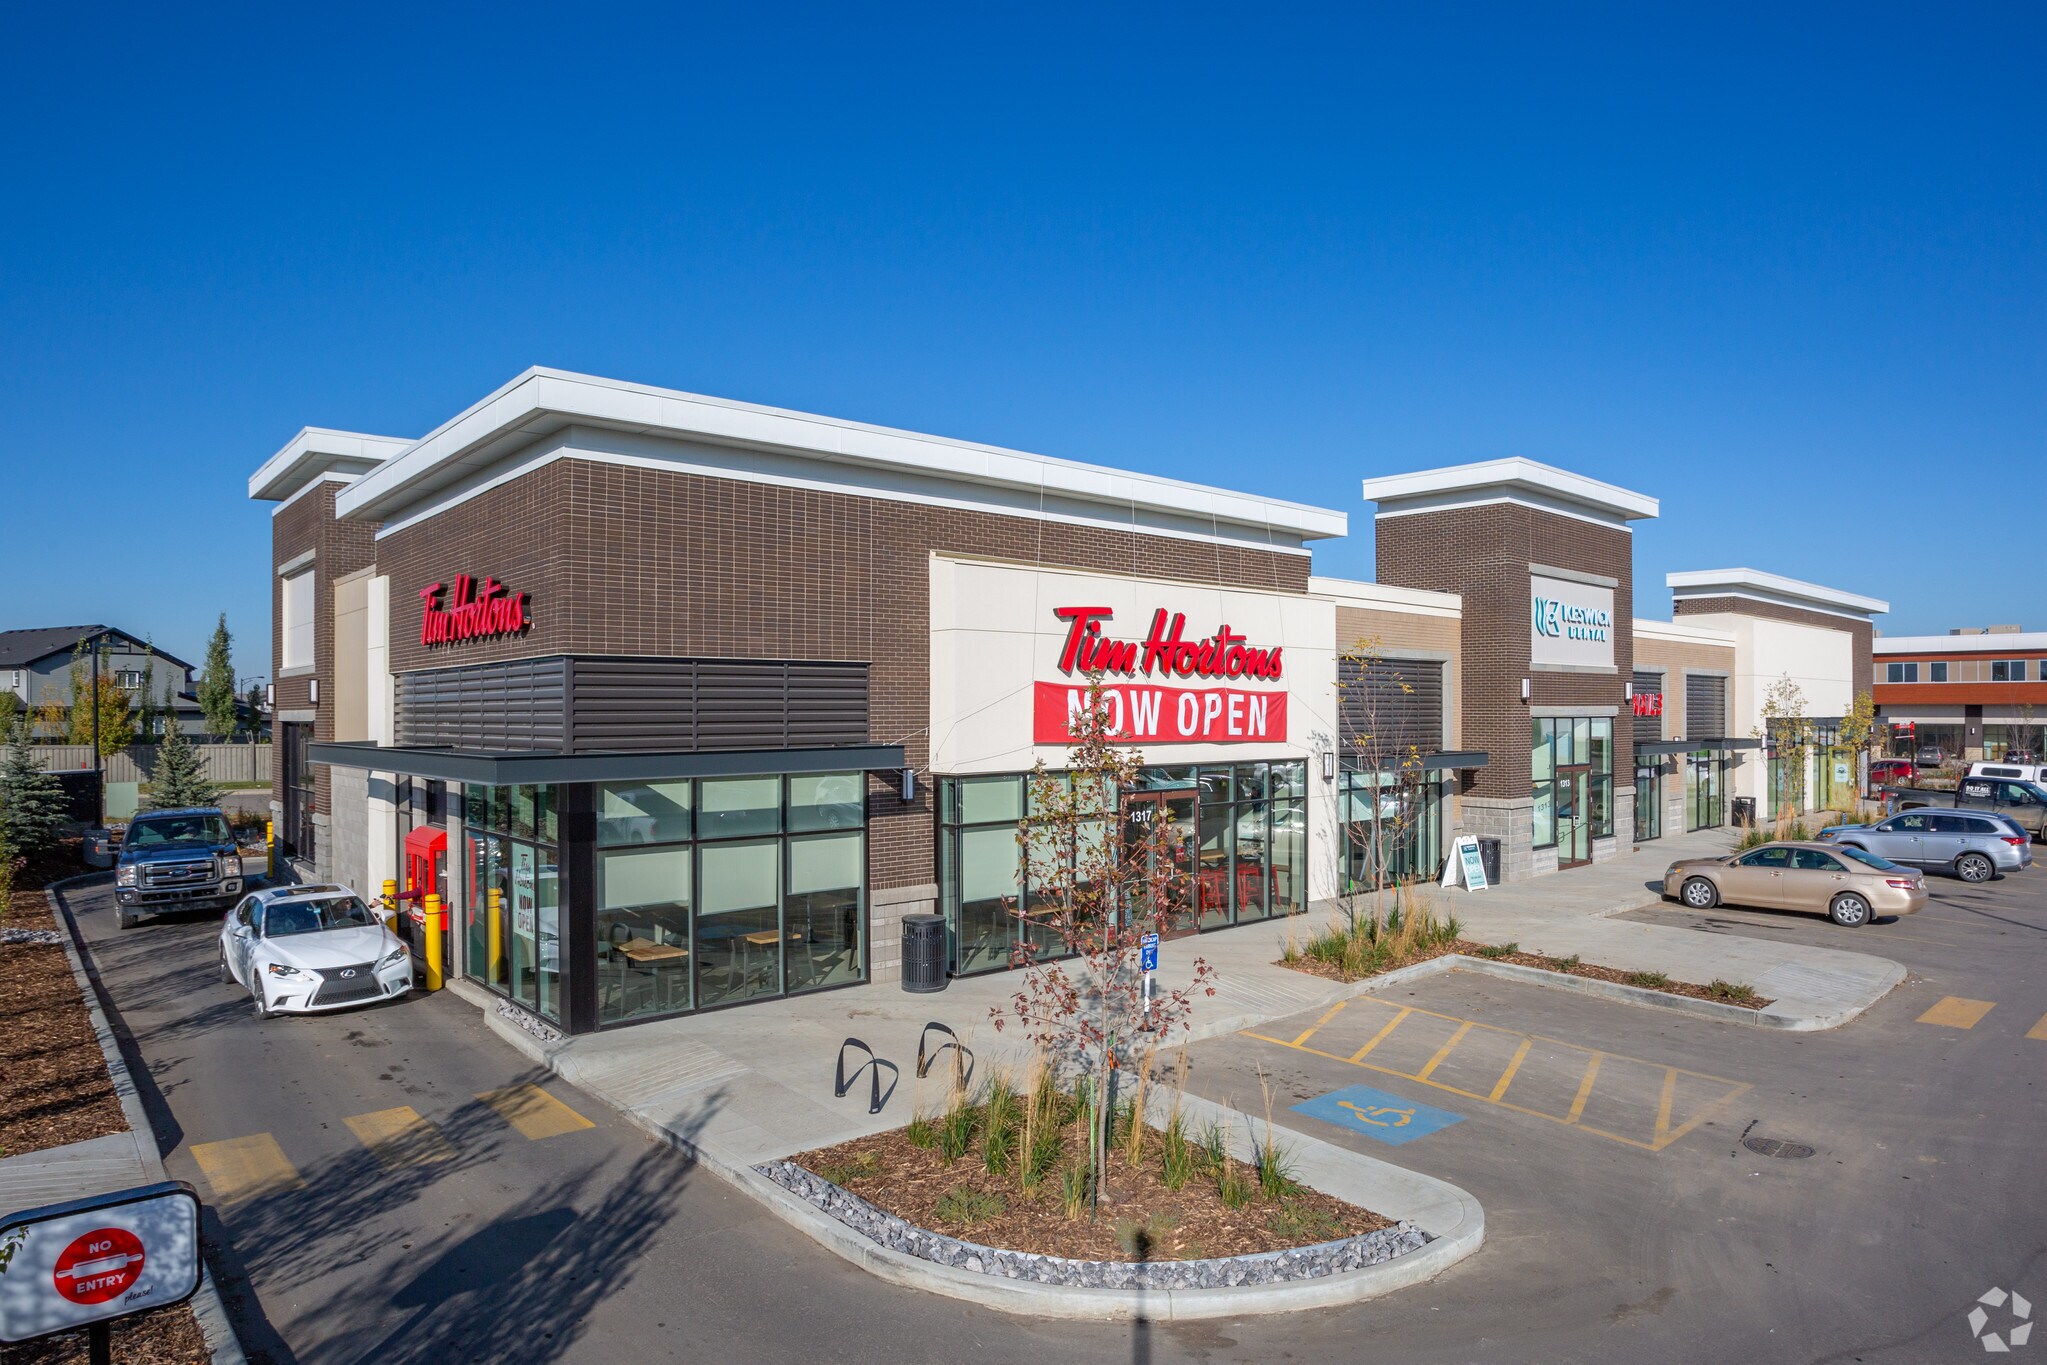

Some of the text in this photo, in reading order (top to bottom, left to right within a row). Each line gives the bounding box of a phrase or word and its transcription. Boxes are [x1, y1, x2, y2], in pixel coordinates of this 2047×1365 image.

[420, 573, 524, 646] Tim Hortons
[1562, 604, 1611, 627] KESWICK
[1053, 606, 1284, 682] Tim Hortons
[1067, 689, 1268, 737] NOW OPEN
[1131, 810, 1151, 822] 1317
[88, 1240, 112, 1254] NO
[76, 1273, 126, 1294] ENTRY
[124, 1285, 154, 1305] please!
